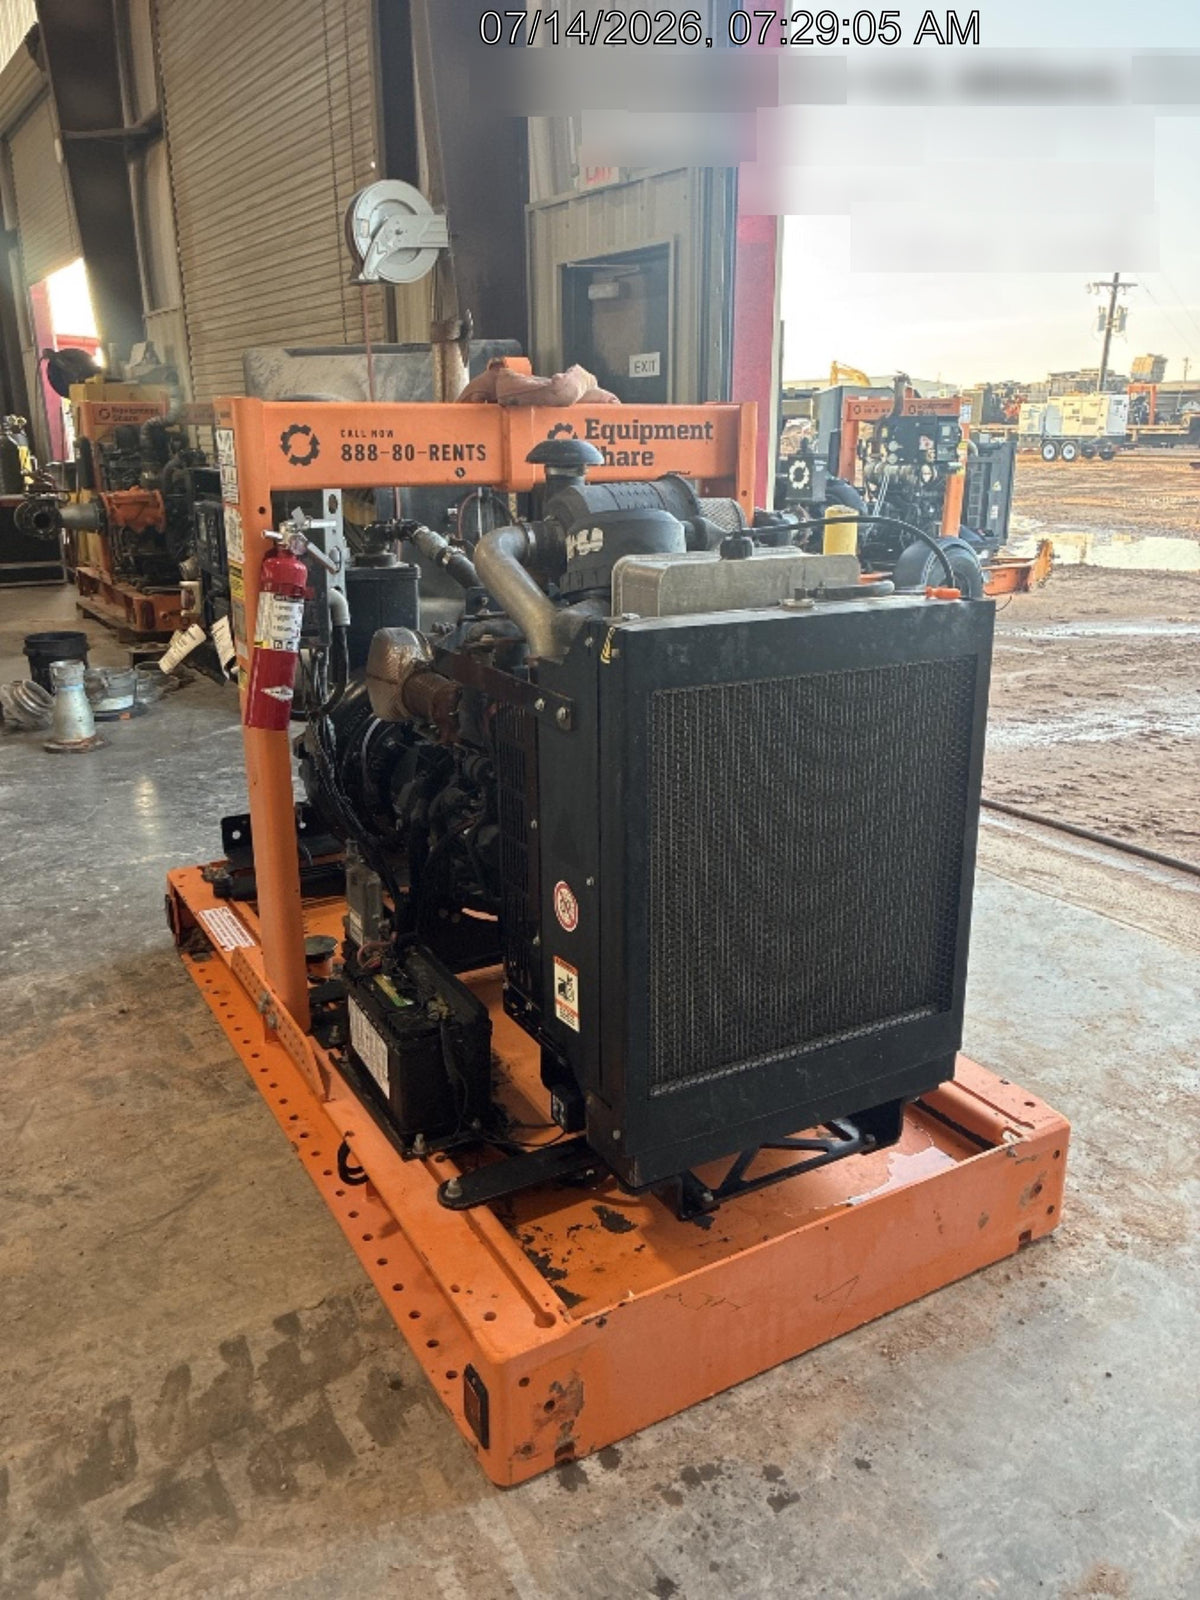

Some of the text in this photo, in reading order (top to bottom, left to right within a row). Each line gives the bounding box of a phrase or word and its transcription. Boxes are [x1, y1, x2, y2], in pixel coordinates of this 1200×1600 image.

[634, 360, 655, 374] EXIT
[340, 429, 394, 438] CALL NOW
[585, 418, 713, 445] Equipment
[341, 444, 486, 462] 888-80-RENTS
